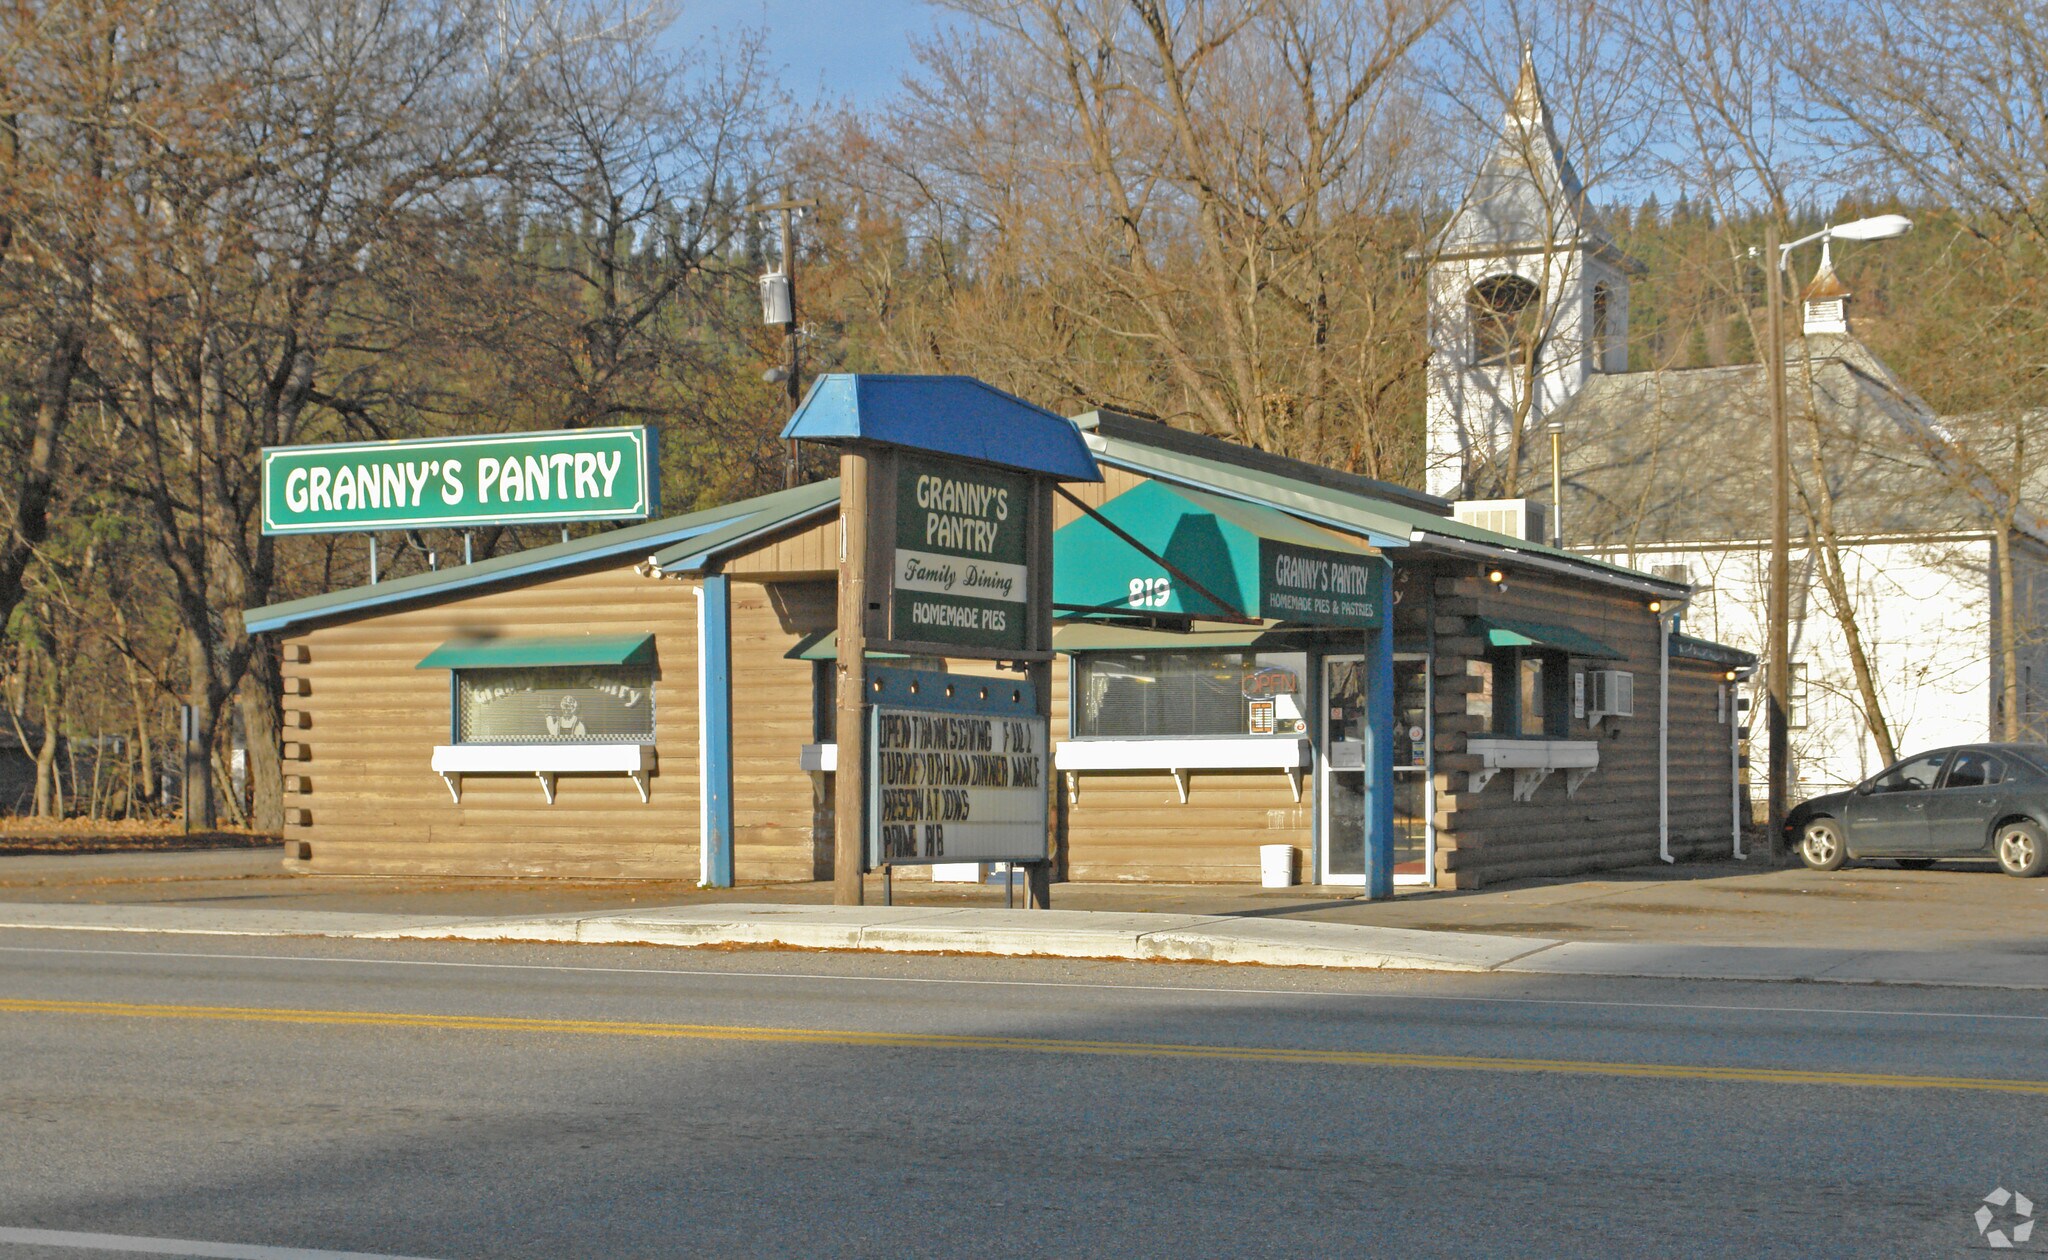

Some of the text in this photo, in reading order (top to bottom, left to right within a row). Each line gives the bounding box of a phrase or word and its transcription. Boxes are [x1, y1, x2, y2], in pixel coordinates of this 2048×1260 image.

[285, 450, 622, 513] GRANNY'S PANTRY
[916, 474, 1008, 521] GRANNY'S
[926, 512, 998, 554] PANTRY
[904, 558, 1013, 597] Family Dining
[1128, 577, 1171, 608] 819
[1275, 554, 1328, 592] GRANNY'S
[1331, 562, 1369, 595] PANTRY
[912, 602, 1006, 631] HOMEMADE PIES
[1269, 593, 1374, 617] HOMEMADE PIES & PASTRIES
[879, 714, 1032, 753] OPEN THANKSGIVING FULL
[879, 751, 1040, 787] TURKEY OR HAM DINNER MAKE
[882, 788, 970, 821] RESERVATIONS
[882, 824, 944, 858] PRIME RIB
